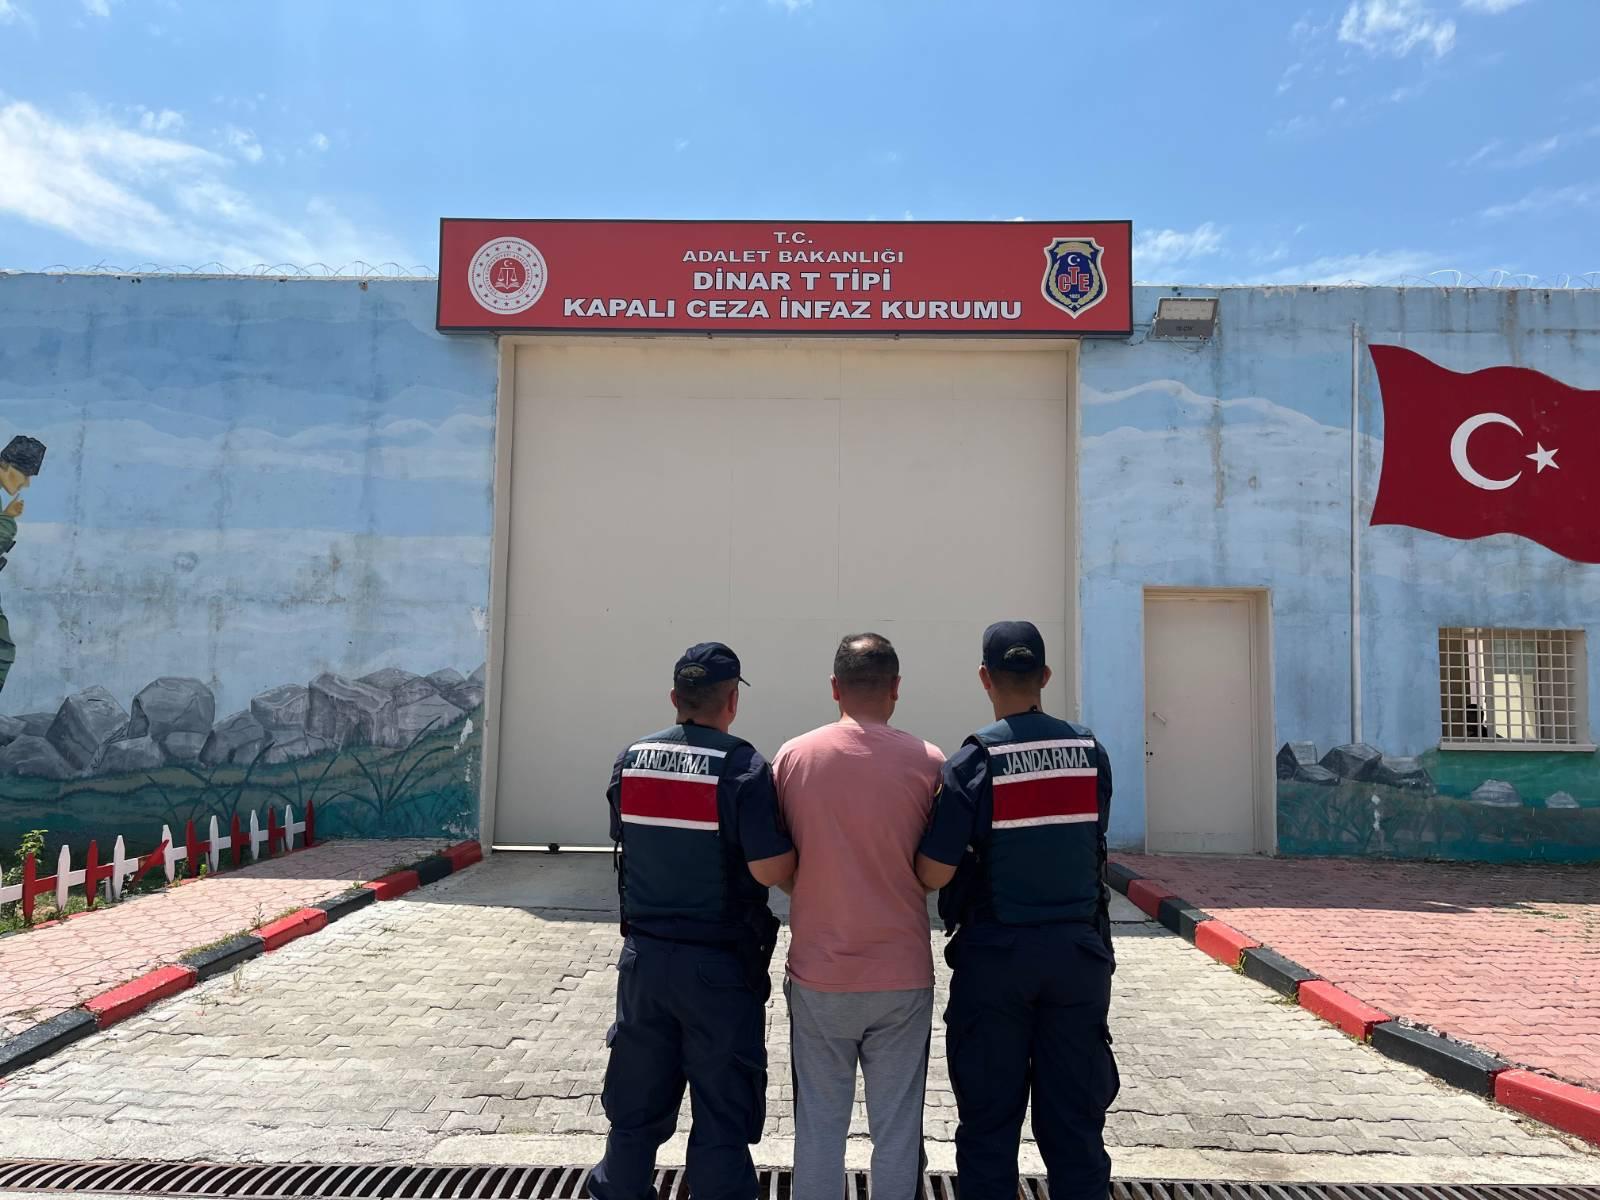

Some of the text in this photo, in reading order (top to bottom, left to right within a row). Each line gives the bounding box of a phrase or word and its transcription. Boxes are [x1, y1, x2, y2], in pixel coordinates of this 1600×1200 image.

[773, 231, 813, 244] T.C.
[682, 248, 904, 263] ADALET BAKANLIĞI
[693, 267, 891, 291] DİNAR T TİPİ
[564, 296, 1022, 319] KAPALI CEZA İNFAZ KURUMU
[630, 749, 710, 775] JANDARMA
[1002, 747, 1091, 775] JANDARMA
